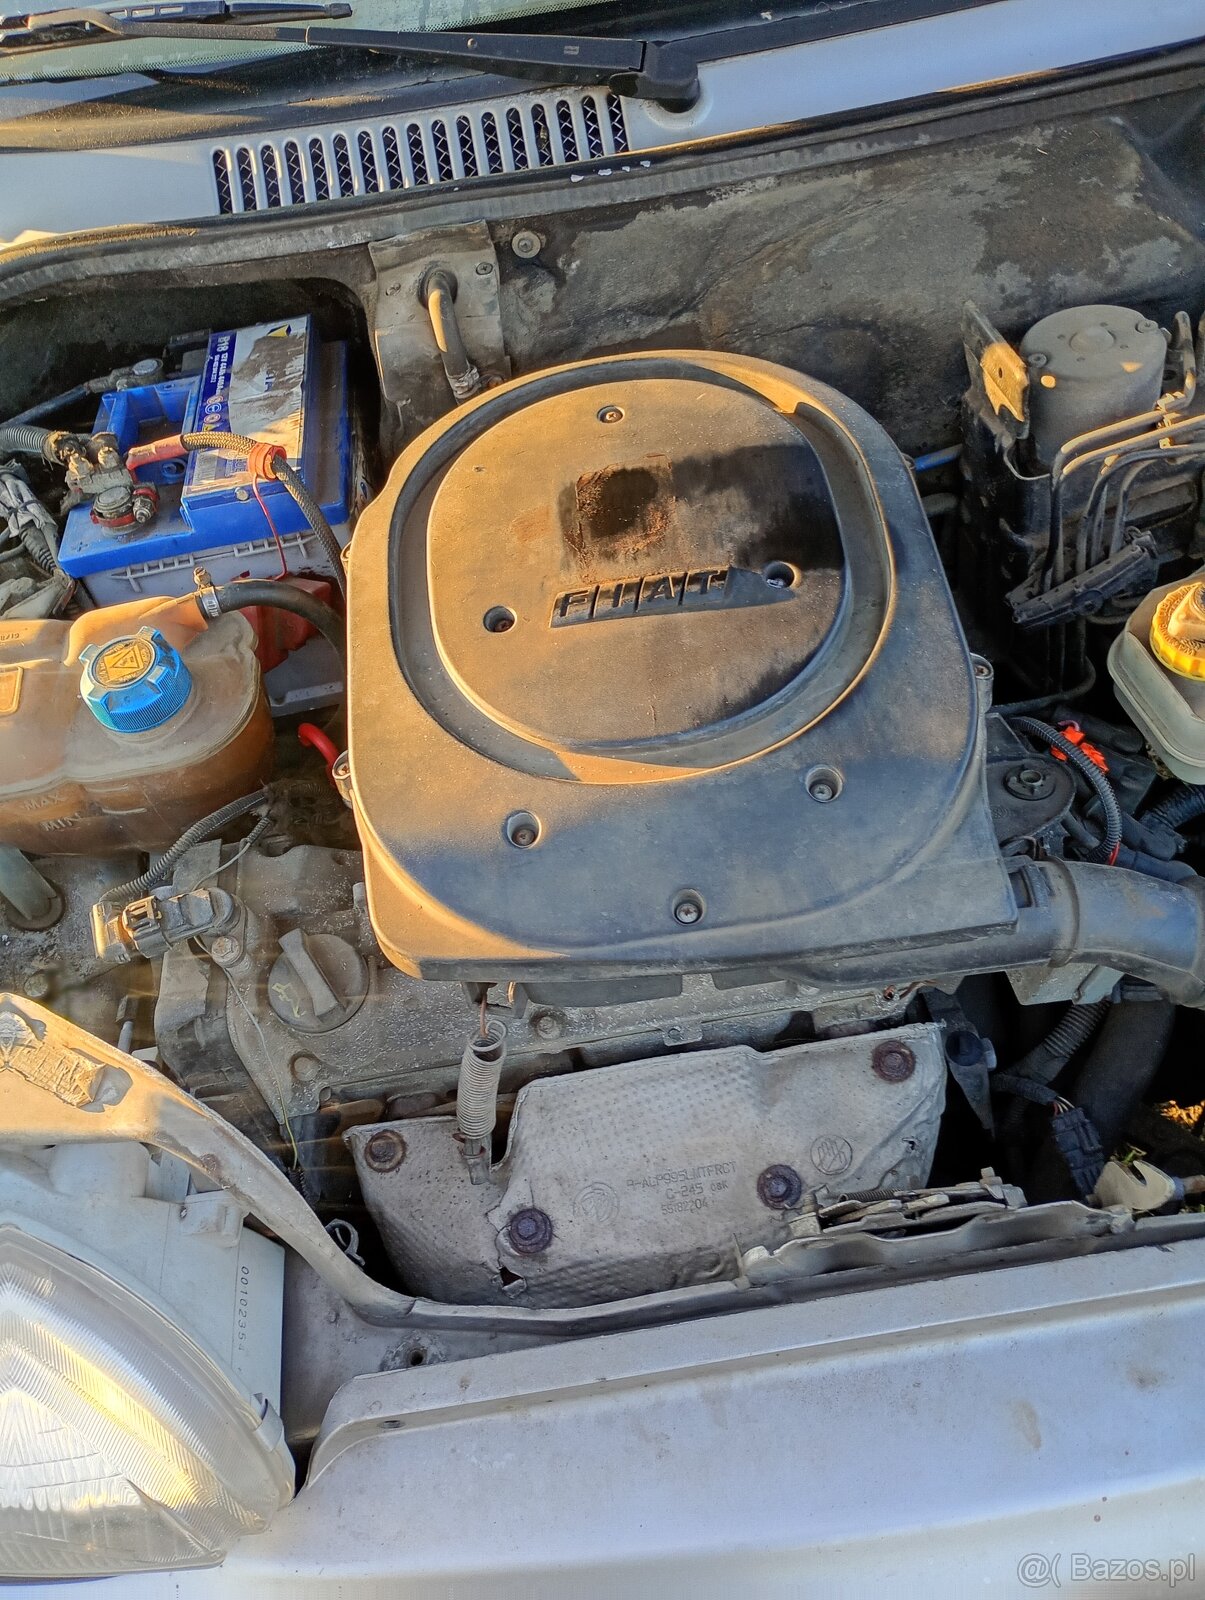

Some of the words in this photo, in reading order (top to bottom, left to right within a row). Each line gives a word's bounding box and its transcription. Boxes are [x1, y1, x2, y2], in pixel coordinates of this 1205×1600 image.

[216, 335, 231, 352] B18
[559, 569, 730, 619] FIAT
[40, 811, 82, 832] MIN
